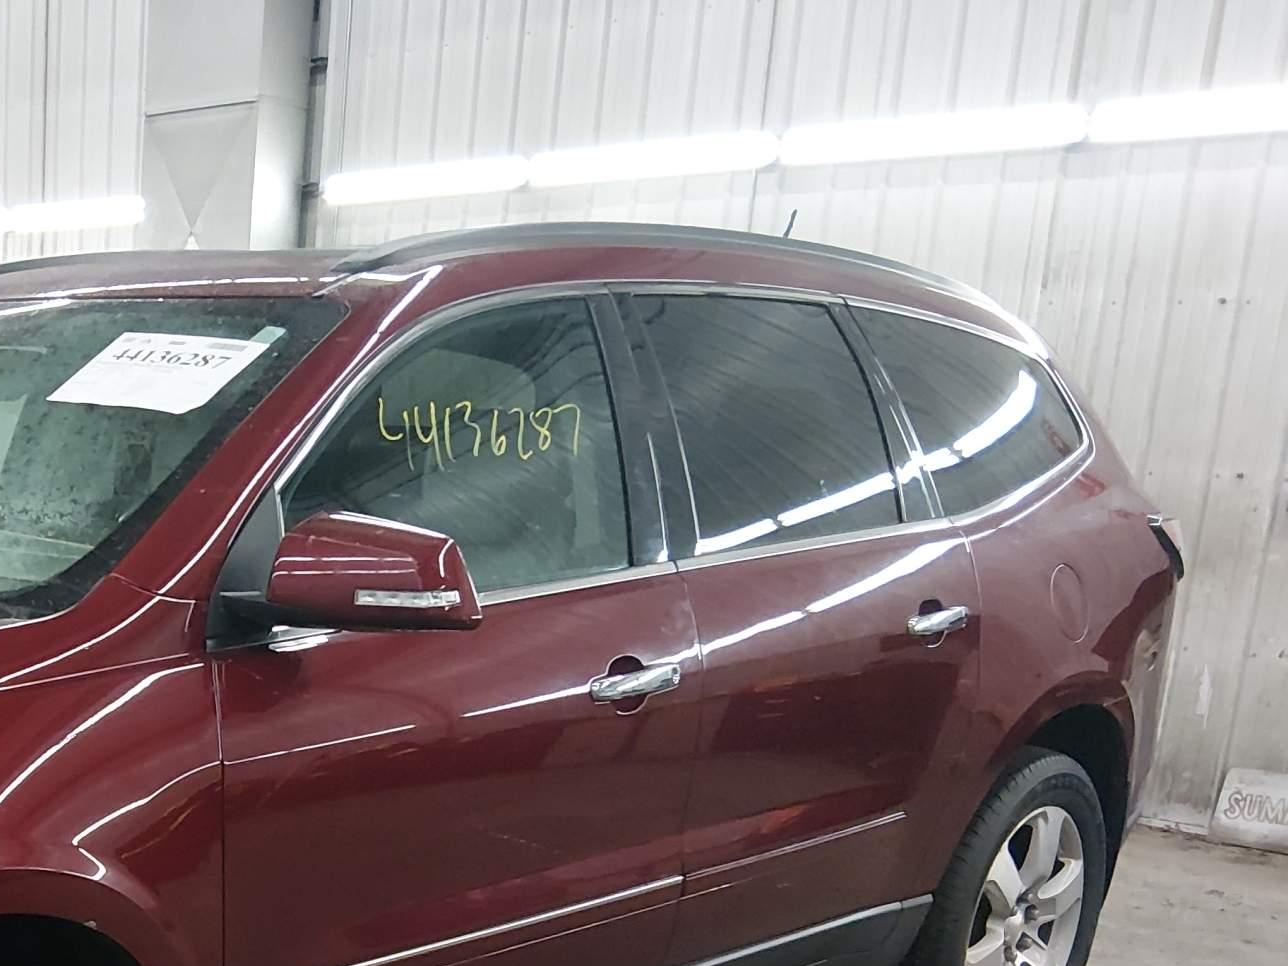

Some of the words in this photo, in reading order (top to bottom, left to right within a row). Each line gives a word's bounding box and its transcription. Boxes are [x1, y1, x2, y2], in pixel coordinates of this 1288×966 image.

[112, 348, 232, 370] 44136287
[378, 399, 580, 471] 44136287
[1224, 791, 1288, 825] SUM
